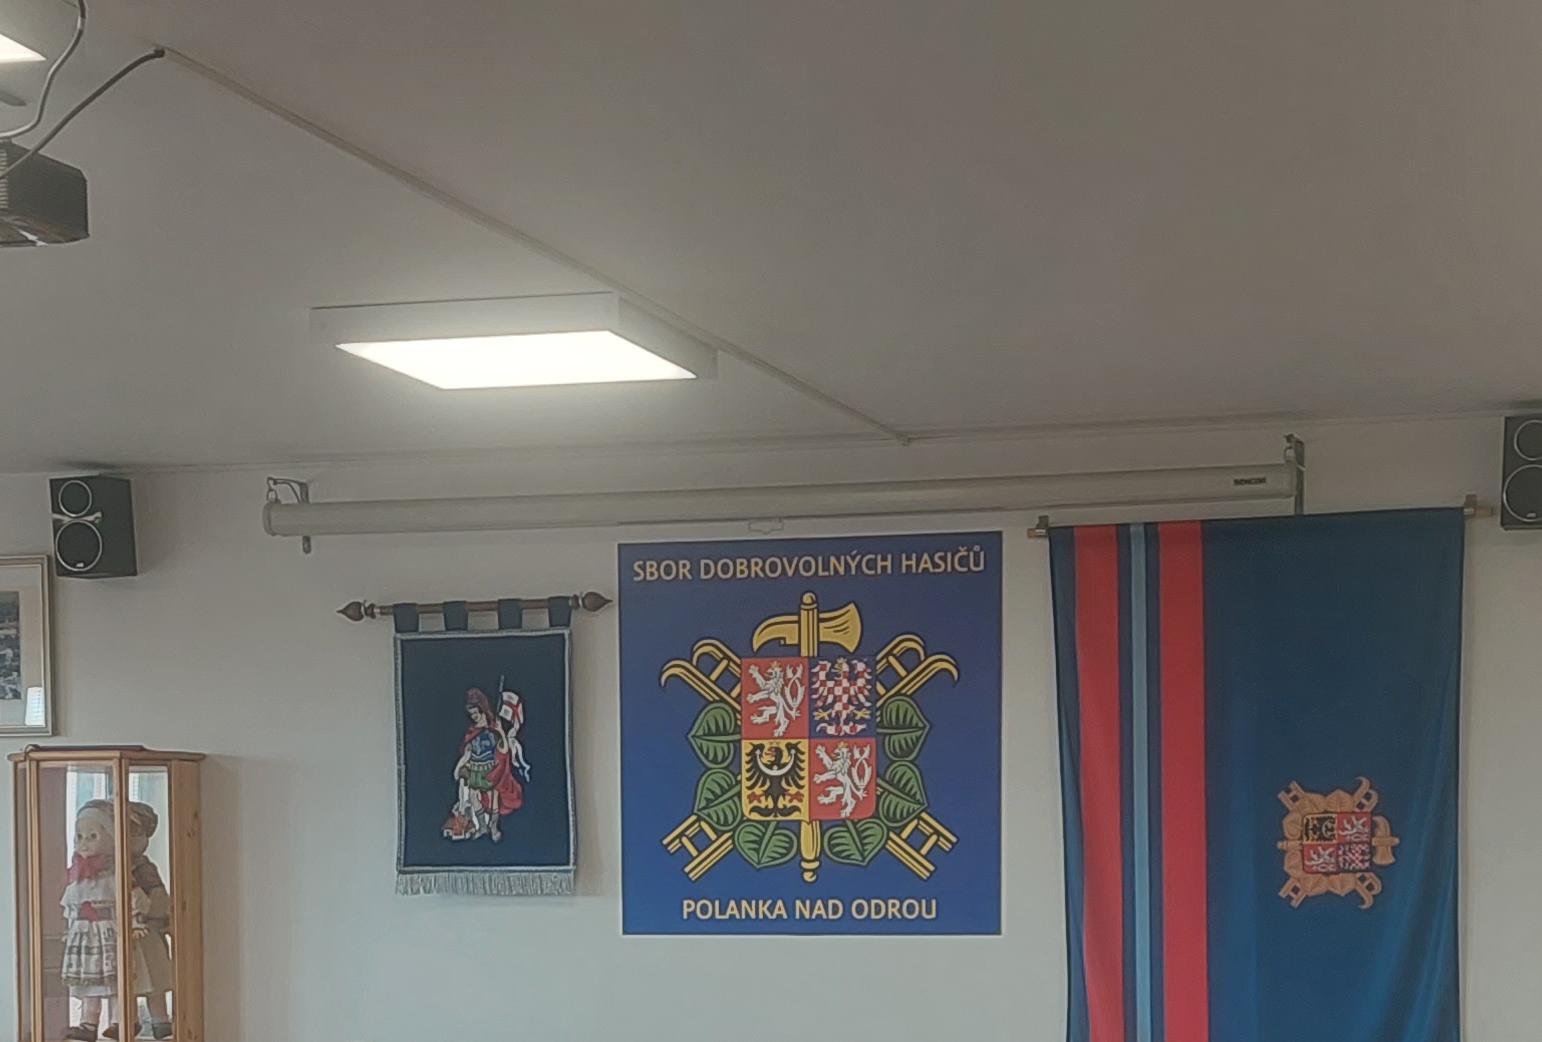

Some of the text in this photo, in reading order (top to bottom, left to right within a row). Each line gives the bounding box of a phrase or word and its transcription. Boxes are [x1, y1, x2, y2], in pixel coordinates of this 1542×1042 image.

[632, 545, 986, 583] SBOR DOBROVOLNÝCH HASIČŮ
[681, 897, 938, 921] POLANKA NAD ODROU
